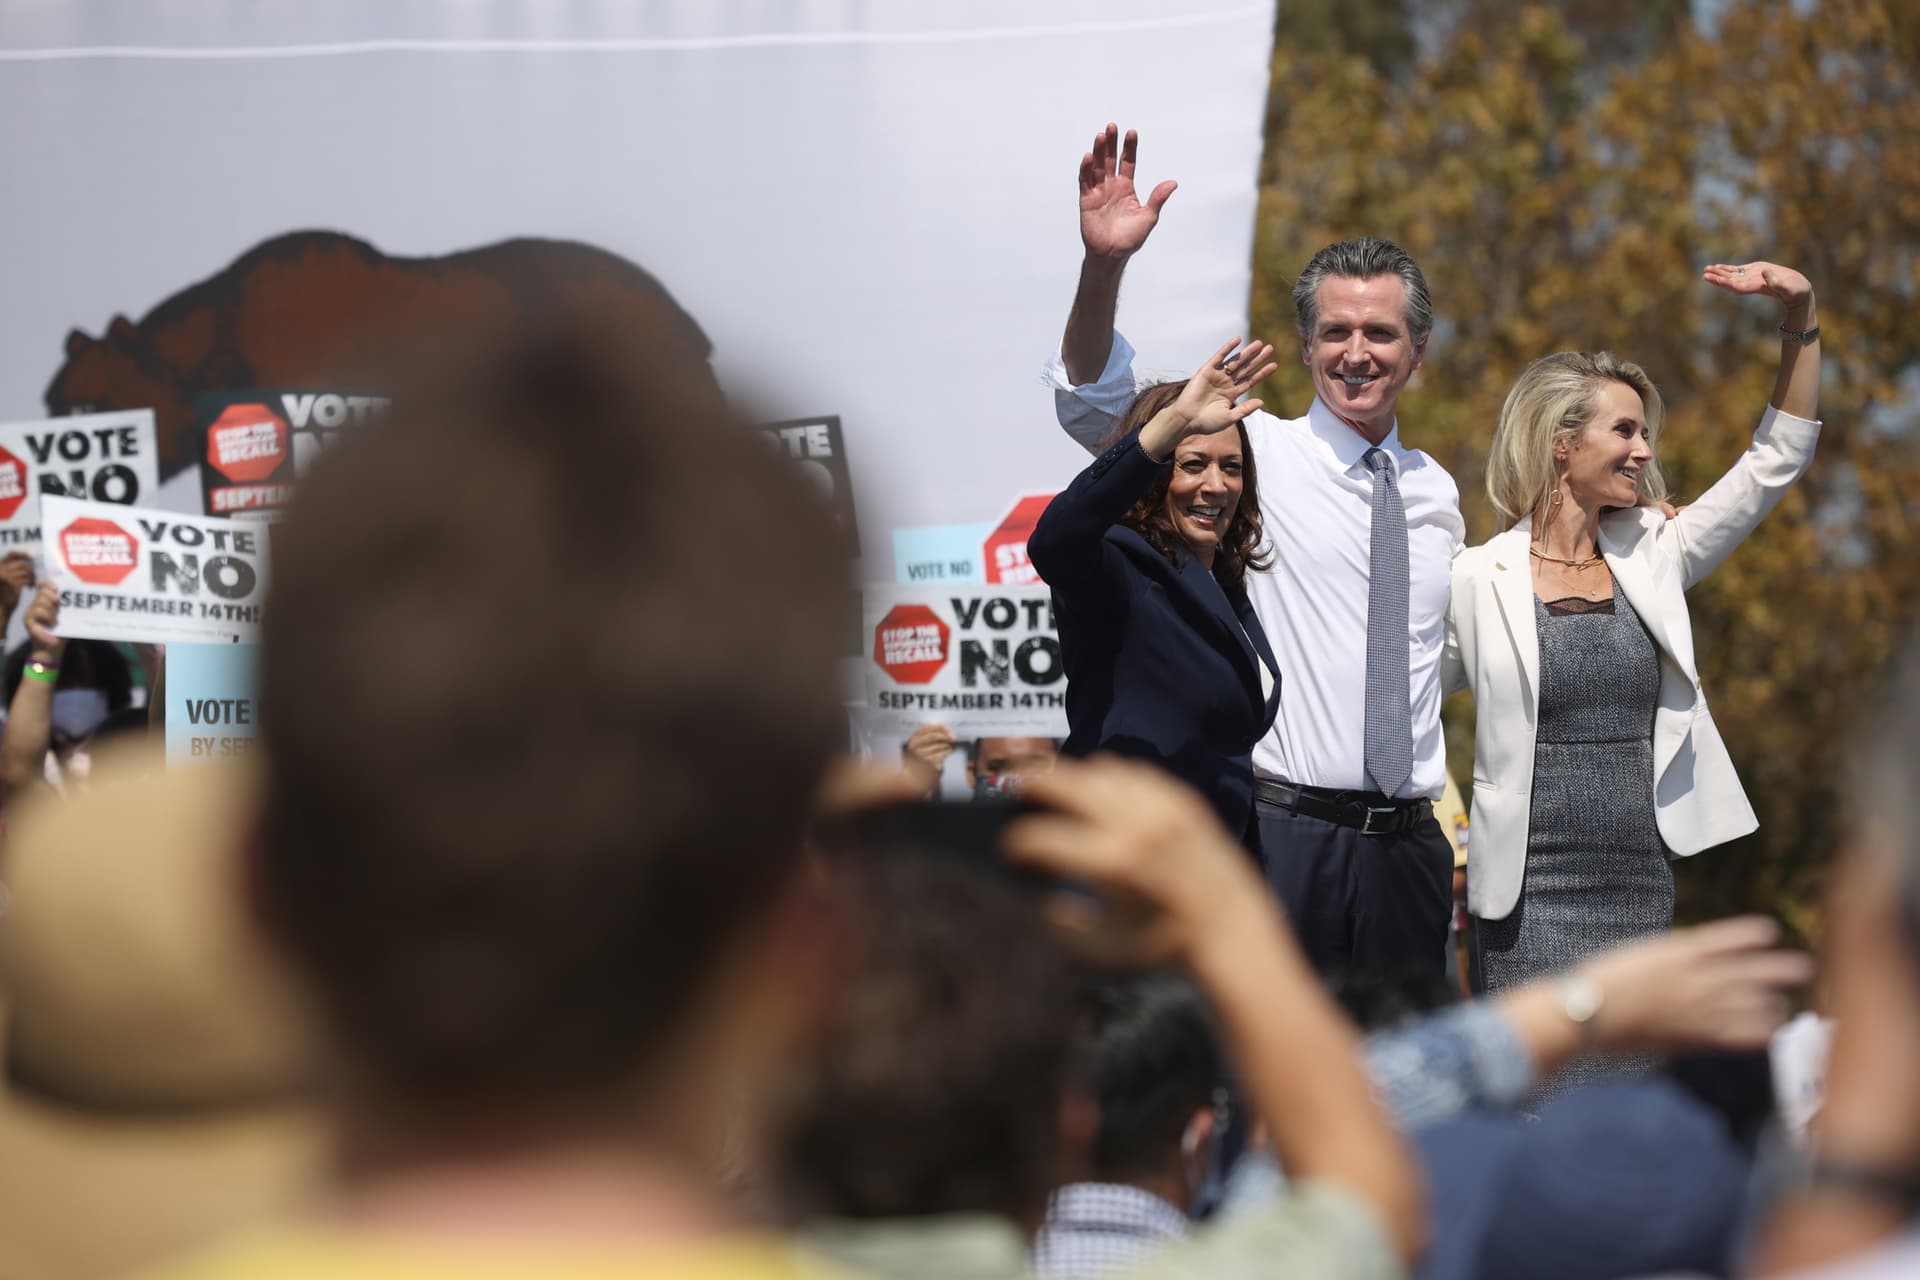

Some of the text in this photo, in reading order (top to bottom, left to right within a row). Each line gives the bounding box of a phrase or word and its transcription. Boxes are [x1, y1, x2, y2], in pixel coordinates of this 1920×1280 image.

[24, 426, 139, 464] VOTE
[38, 464, 139, 505] NO
[138, 519, 257, 555] VOTE
[150, 550, 257, 599] NO
[907, 560, 973, 581] VOTE NO
[60, 590, 261, 624] SEPTEMBER 14TH!
[885, 646, 945, 665] RECALL
[959, 635, 1065, 687] NO
[185, 699, 251, 725] VOTE
[878, 691, 1065, 710] SEPTEMBER 14TH
[191, 737, 216, 757] BY
